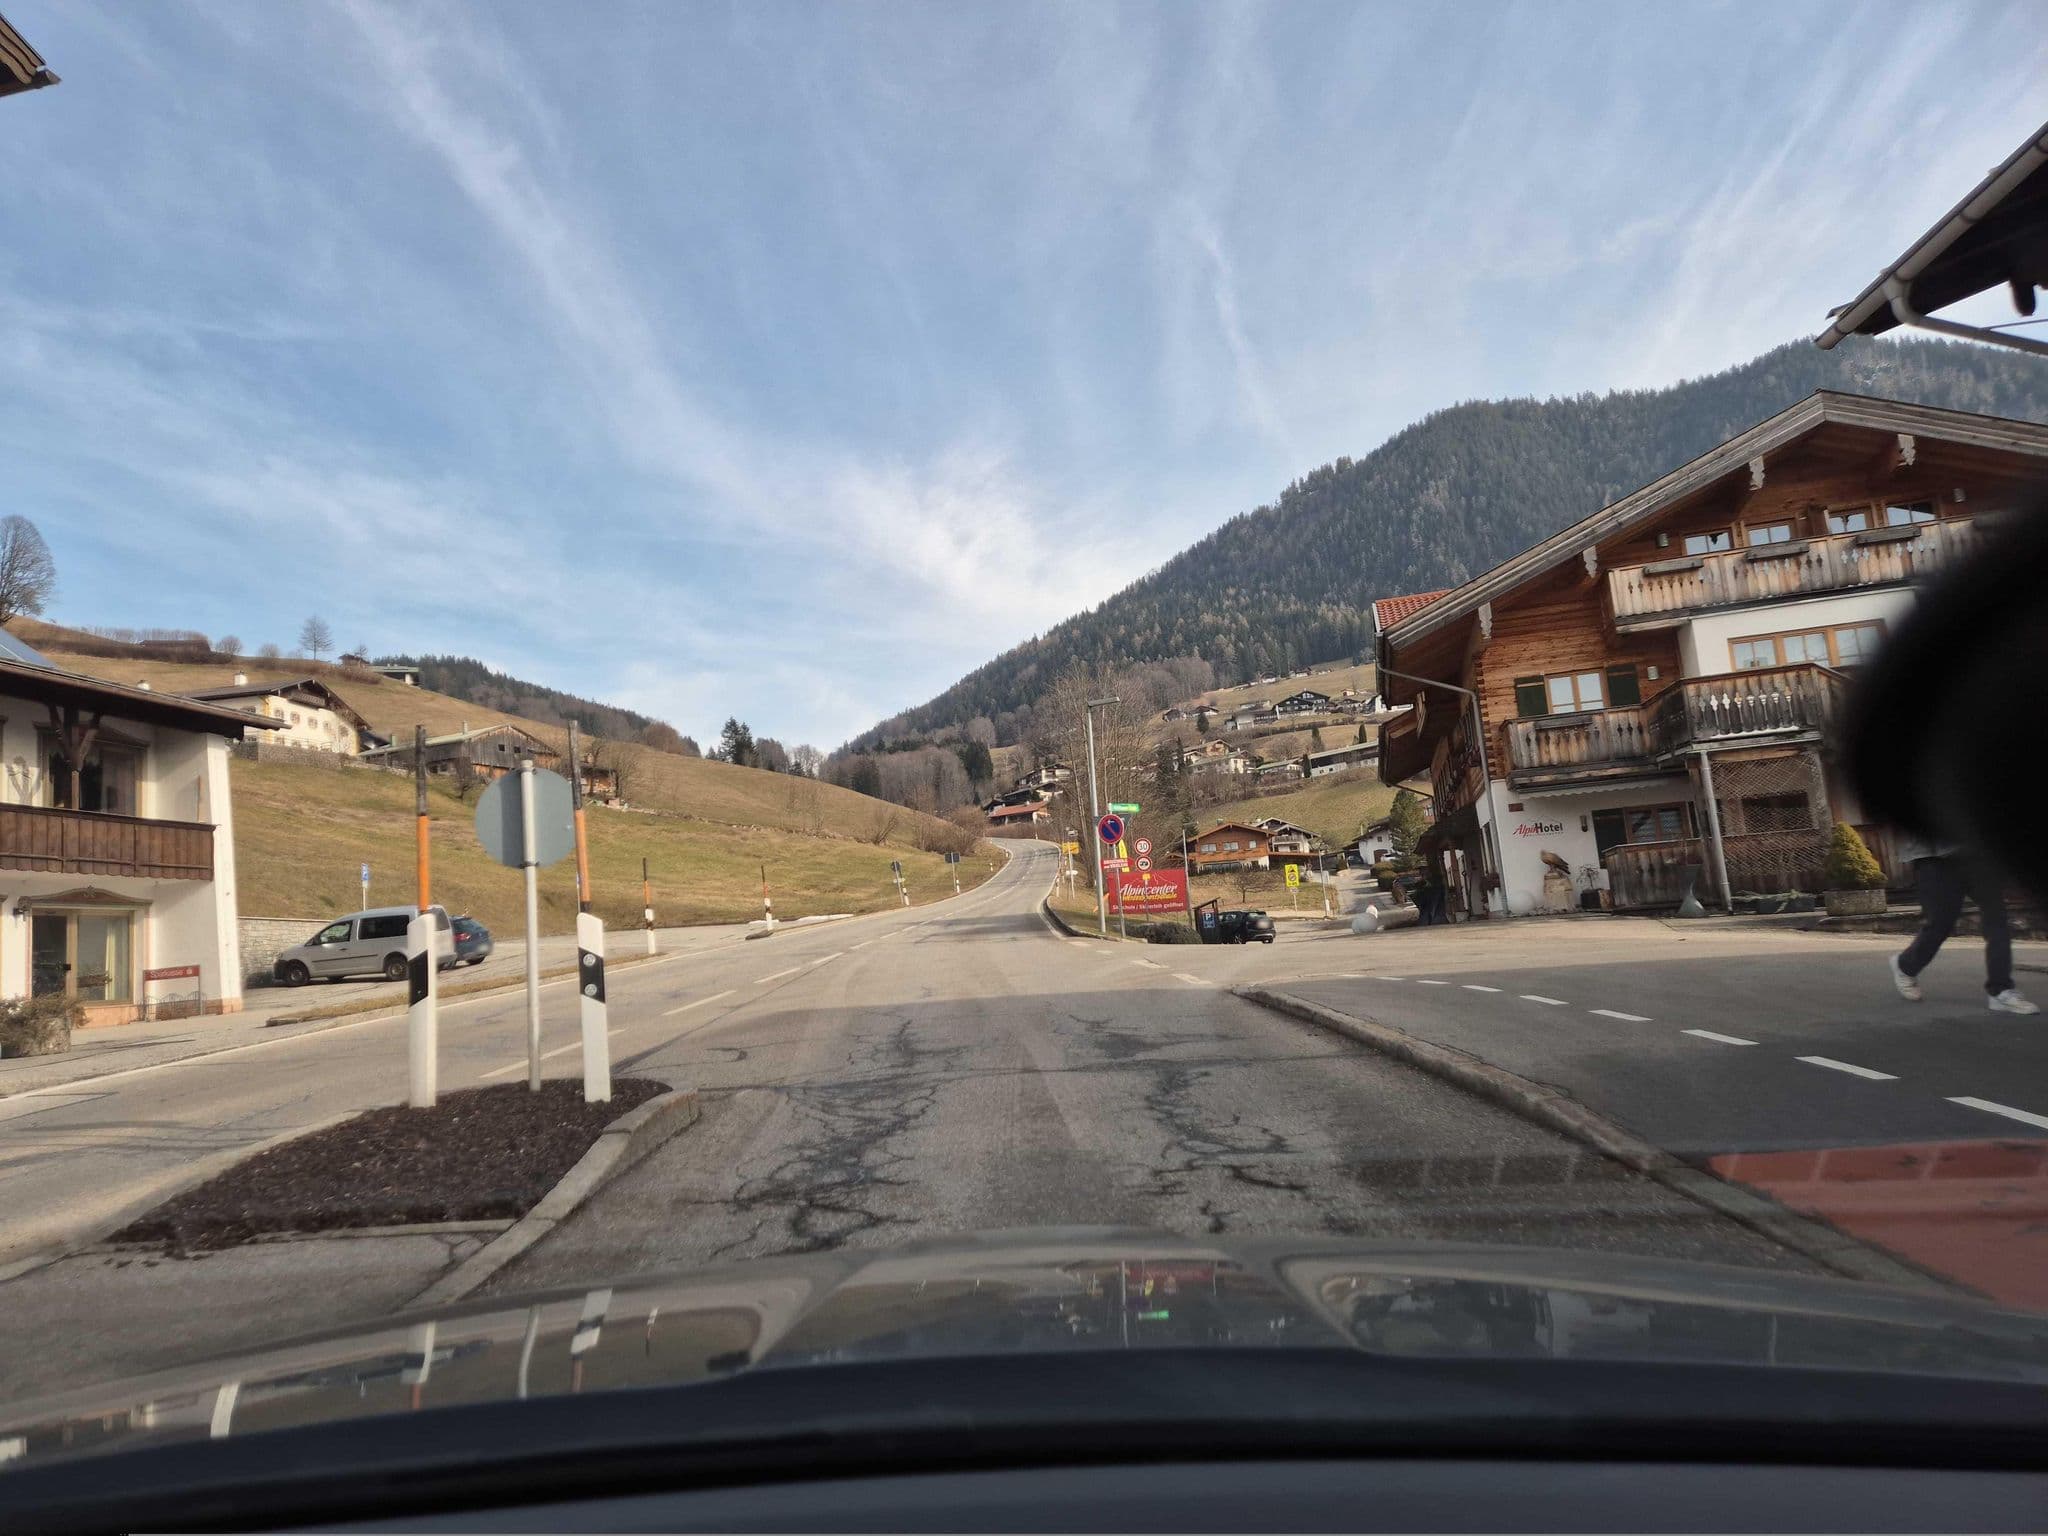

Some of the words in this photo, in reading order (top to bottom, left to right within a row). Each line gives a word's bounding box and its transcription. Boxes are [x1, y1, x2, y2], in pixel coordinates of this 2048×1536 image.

[1138, 842, 1148, 851] 30
[1120, 884, 1177, 896] Alpincenter
[1205, 913, 1212, 921] P
